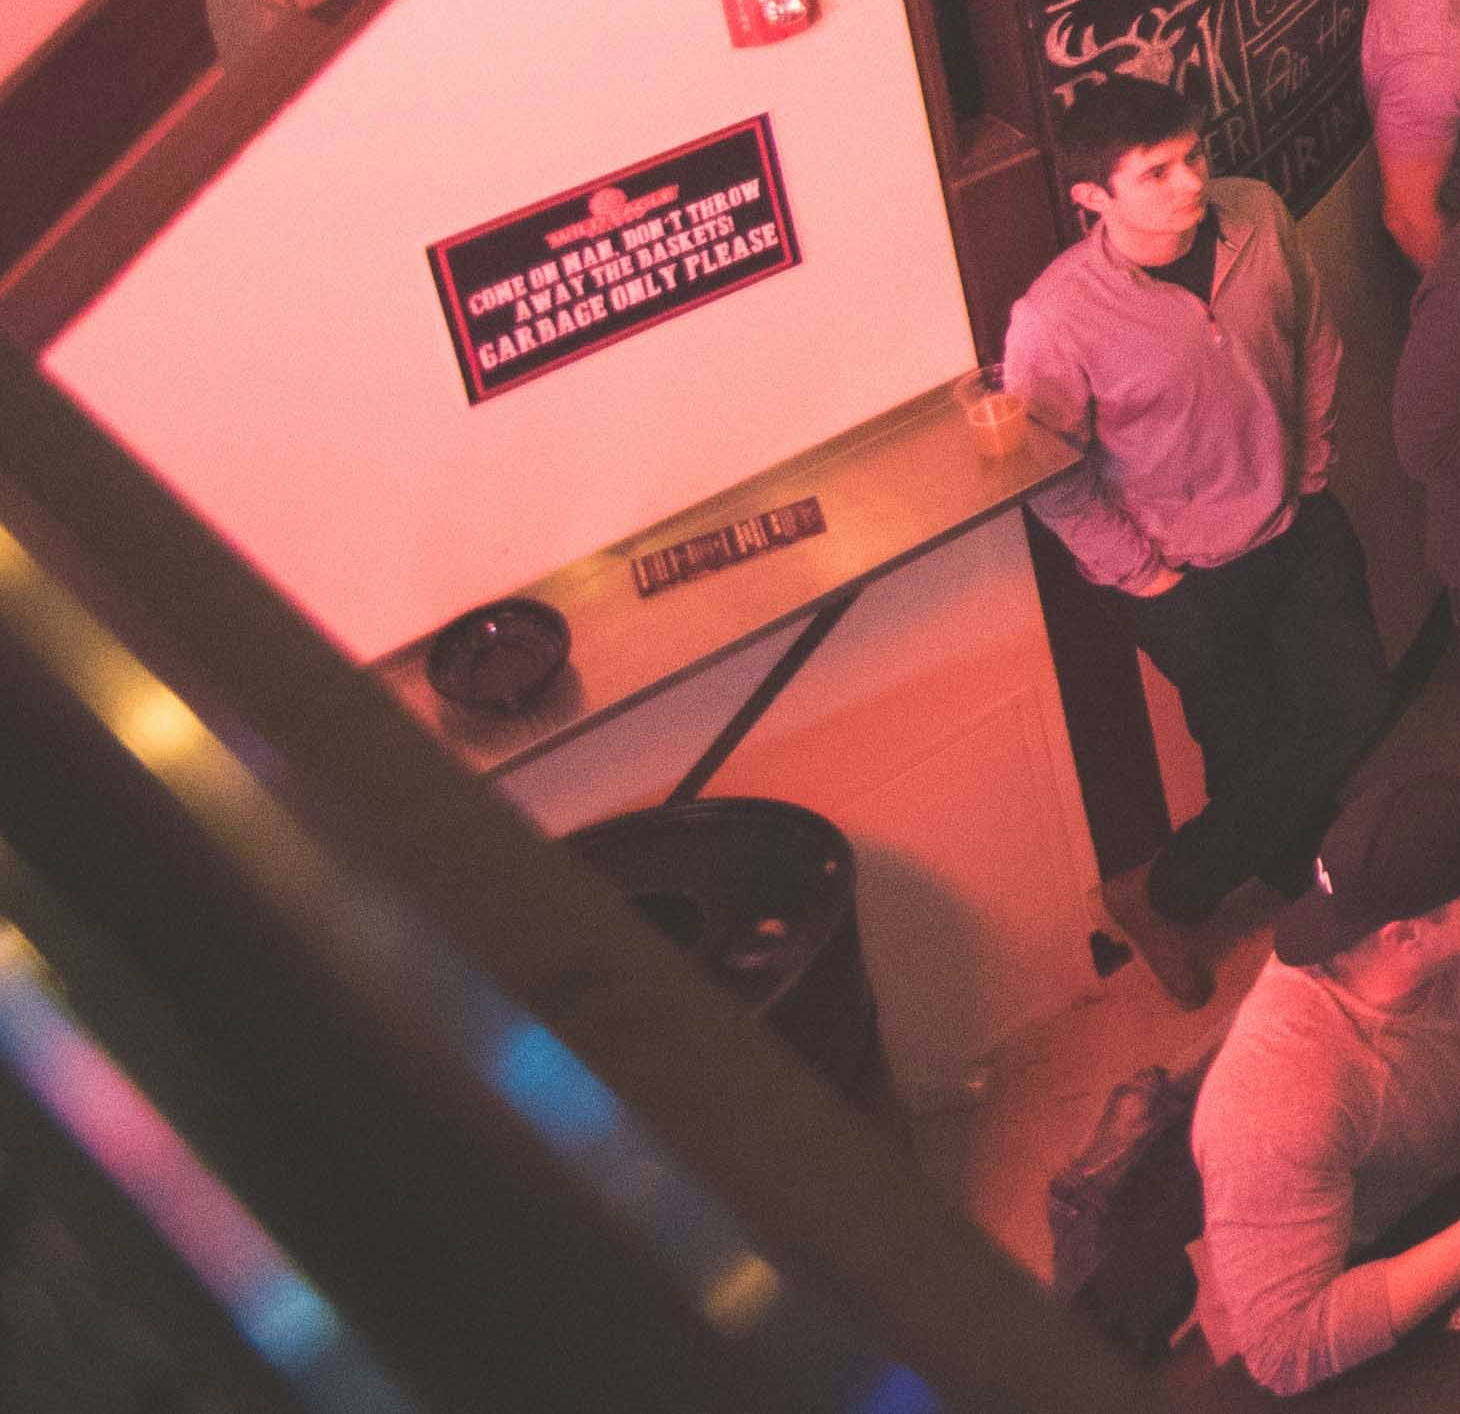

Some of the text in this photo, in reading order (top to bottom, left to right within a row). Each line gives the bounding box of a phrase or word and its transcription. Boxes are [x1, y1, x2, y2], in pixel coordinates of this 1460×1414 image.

[467, 178, 761, 316] COME ON MAN, DON'T THROW
[478, 222, 780, 371] GARBAGE ONLY PLEASE
[515, 215, 735, 322] AWAY THE BASKETS!
